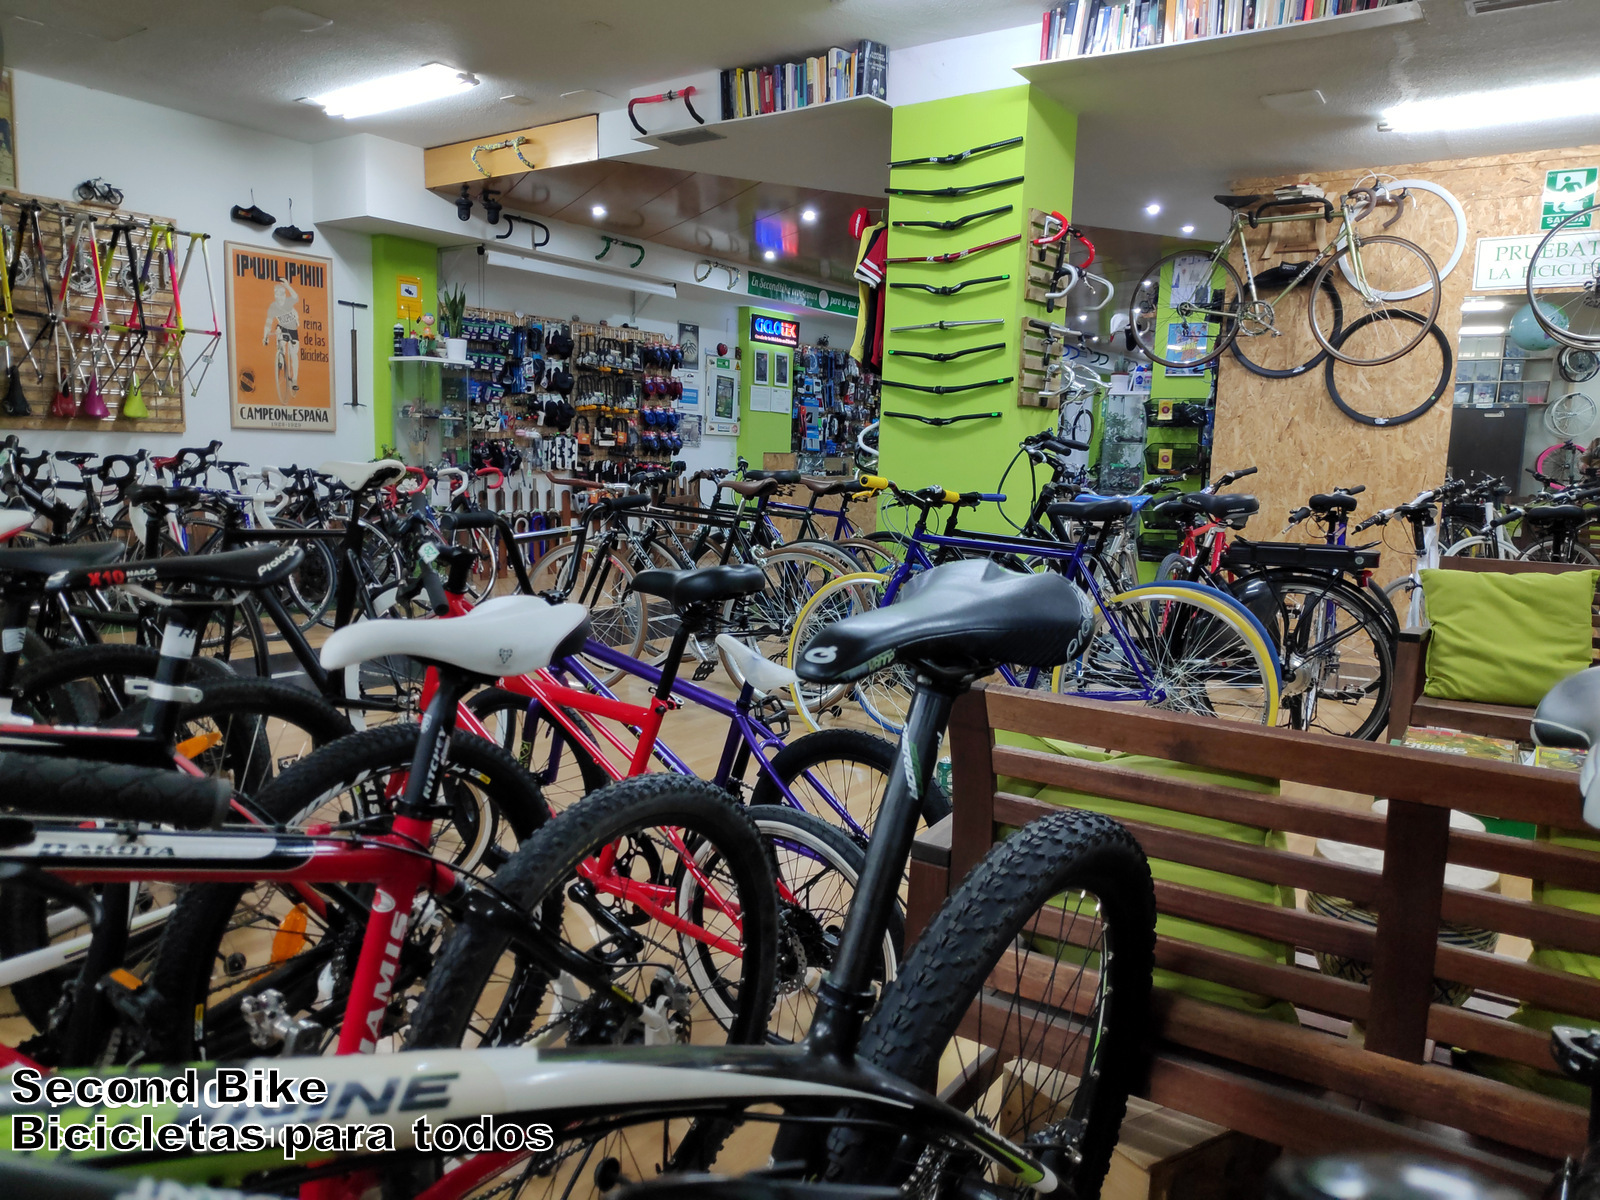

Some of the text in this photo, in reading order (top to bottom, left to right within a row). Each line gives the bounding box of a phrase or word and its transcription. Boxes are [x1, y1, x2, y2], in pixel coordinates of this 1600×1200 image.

[1489, 268, 1511, 280] LA
[751, 276, 759, 287] En
[829, 297, 841, 306] pero
[847, 301, 856, 310] que
[302, 299, 310, 314] la
[303, 316, 323, 331] reina
[303, 333, 326, 347] de las
[300, 348, 329, 363] Bicicletas
[240, 406, 288, 421] CAMPEON
[293, 408, 329, 423] ESPAÑA
[88, 569, 125, 586] X10
[39, 843, 175, 857] DAKOTA
